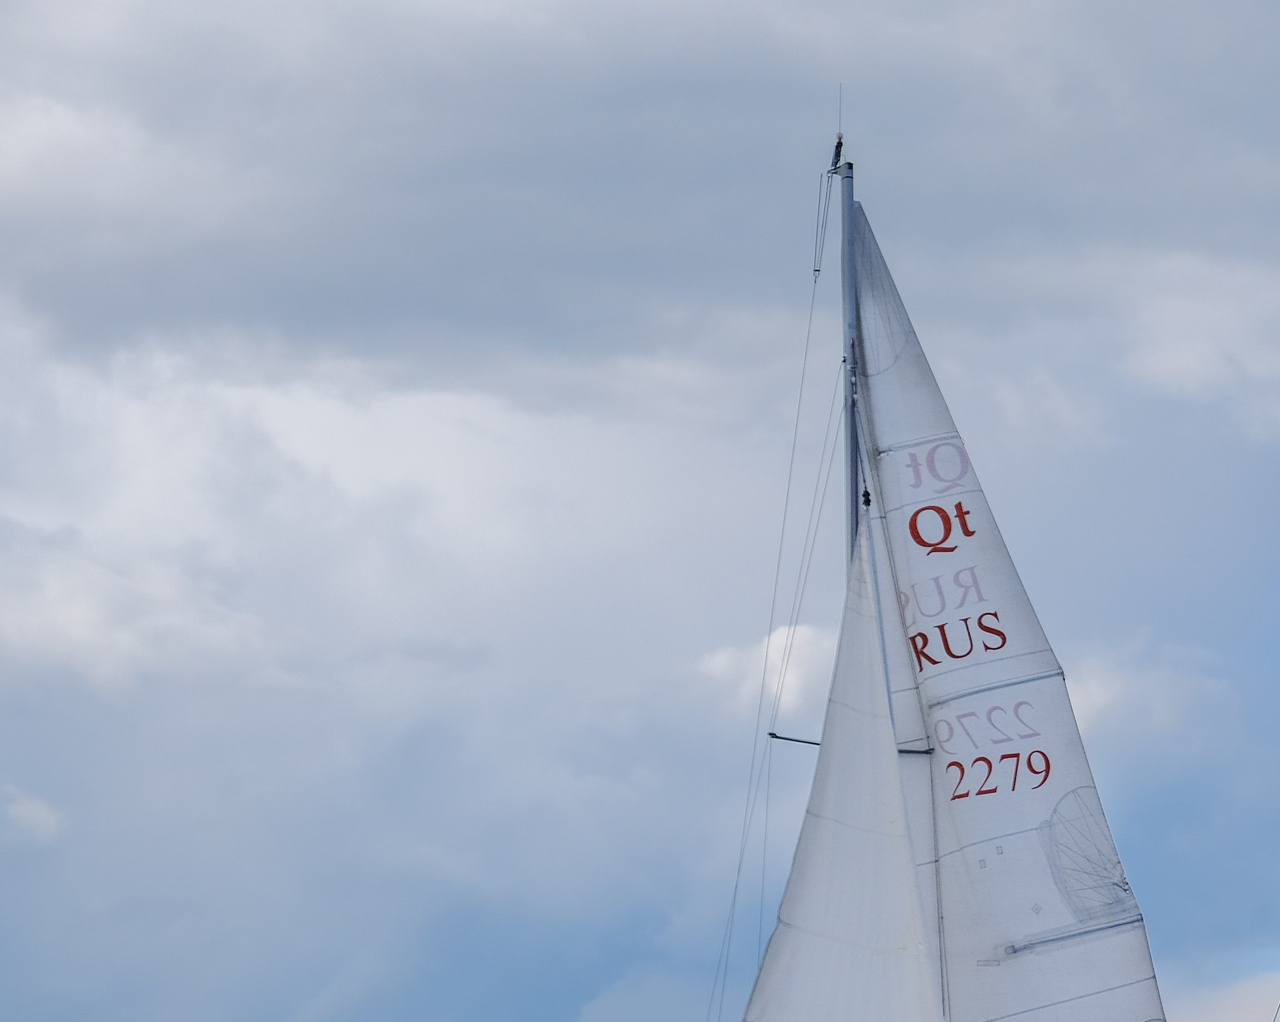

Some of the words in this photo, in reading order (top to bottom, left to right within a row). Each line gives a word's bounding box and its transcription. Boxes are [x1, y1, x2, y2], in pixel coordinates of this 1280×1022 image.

[908, 501, 976, 556] Qt
[908, 610, 1007, 673] RUS
[945, 750, 1051, 801] 2279
